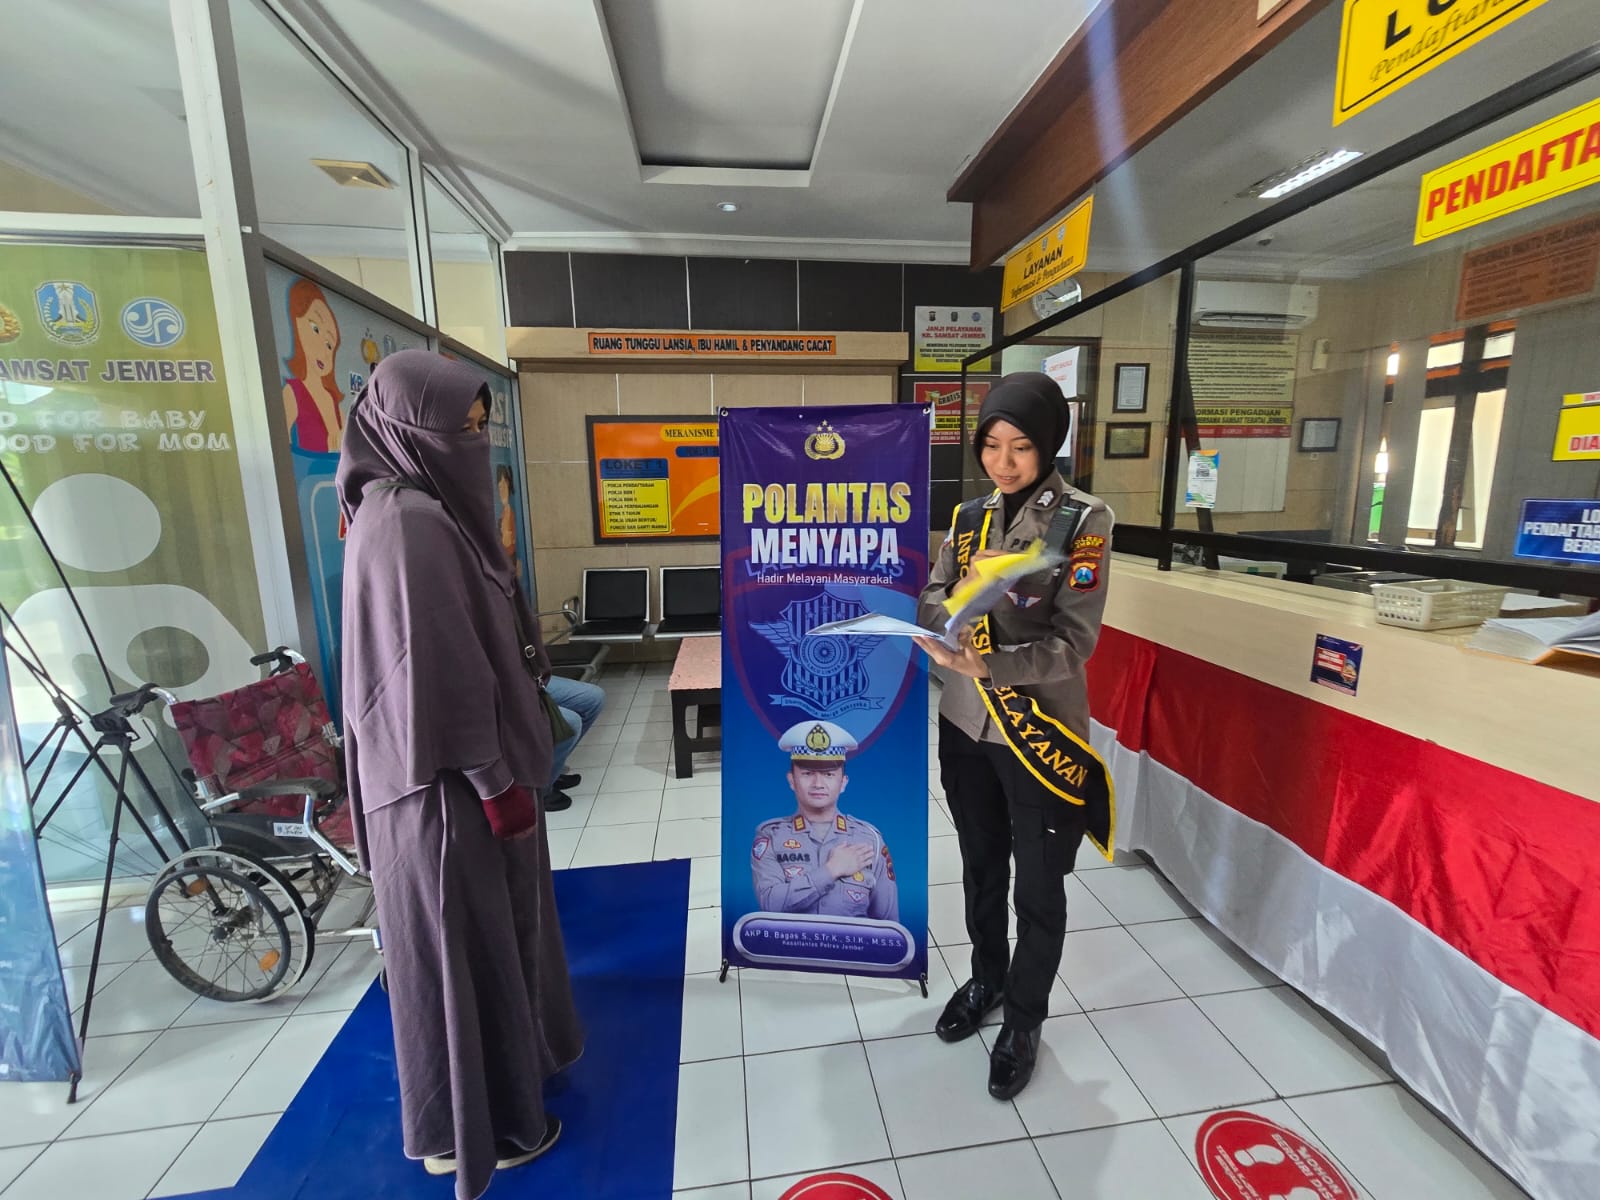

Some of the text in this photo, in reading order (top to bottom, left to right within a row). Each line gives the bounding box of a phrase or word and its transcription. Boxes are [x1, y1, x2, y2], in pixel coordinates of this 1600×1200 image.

[1023, 244, 1064, 280] LAYANAN
[593, 337, 833, 352] RUANG TUNGGU LANSIA, IBU HAMIL & PENYANDANG CACAT
[101, 359, 217, 383] JEMBER
[35, 410, 103, 429] FOR
[120, 410, 205, 430] BABY
[1196, 408, 1281, 416] ORMASI PENGADUAN
[73, 433, 141, 453] FOR
[159, 432, 230, 452] MOM
[665, 428, 714, 438] MEKANISME
[605, 460, 649, 470] LOKET
[743, 482, 912, 524] POLANTAS
[751, 528, 900, 564] MENYAPA
[757, 573, 893, 586] Hadir Melayani Masyarakat
[994, 686, 1088, 788] LAYANAN
[776, 853, 811, 863] BAGAS
[774, 931, 799, 940] Bagas
[1271, 1133, 1314, 1177] BERDIRI
[1297, 1146, 1344, 1195] MOHON
